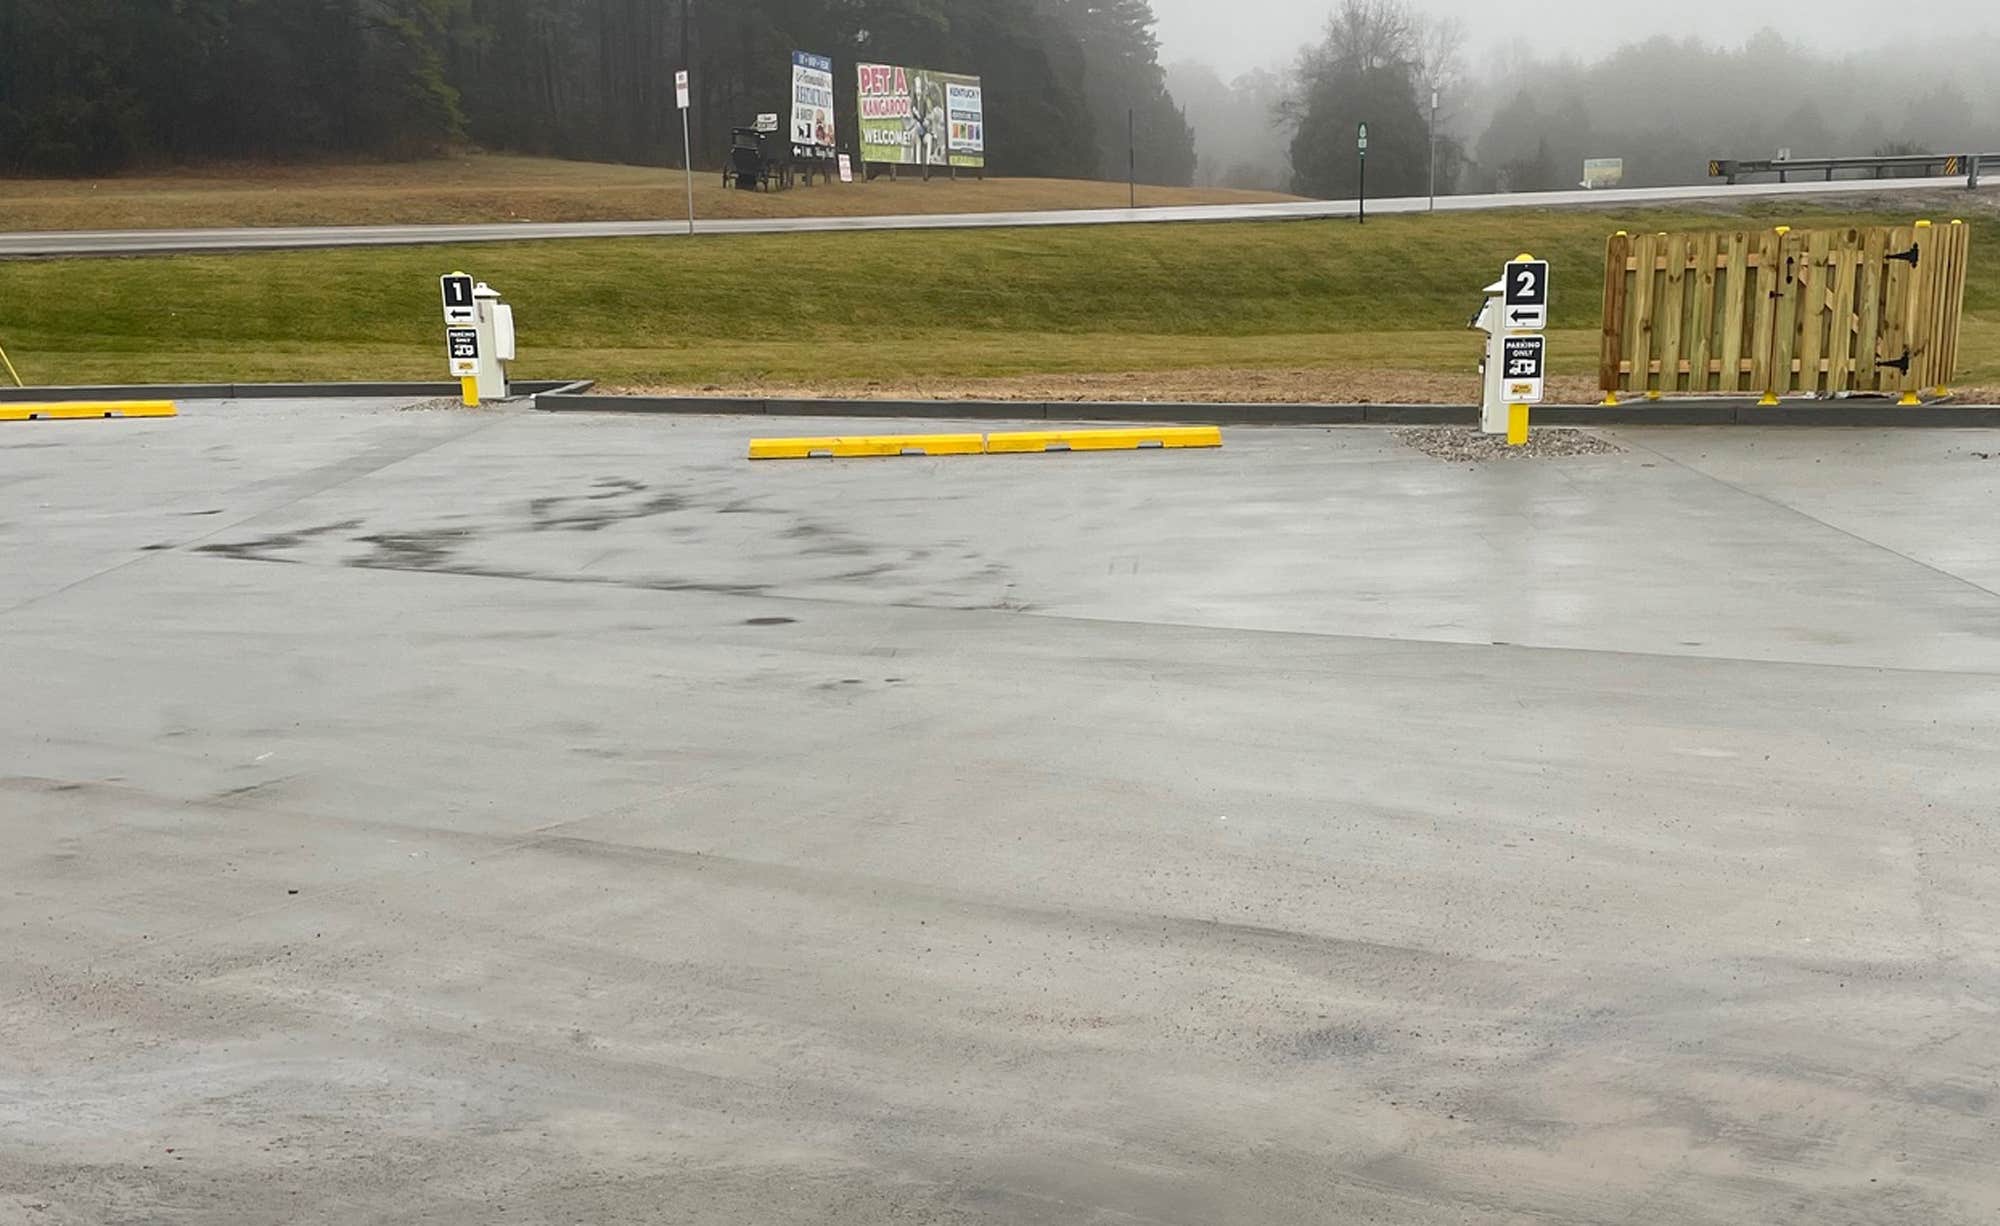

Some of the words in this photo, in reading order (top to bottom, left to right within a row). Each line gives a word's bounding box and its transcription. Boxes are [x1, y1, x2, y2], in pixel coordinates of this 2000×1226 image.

[859, 66, 890, 94] PET
[895, 67, 908, 94] A
[864, 128, 913, 146] WELCOME!
[453, 282, 463, 301] 1
[1516, 271, 1535, 296] 2
[1506, 341, 1541, 349] PARKING
